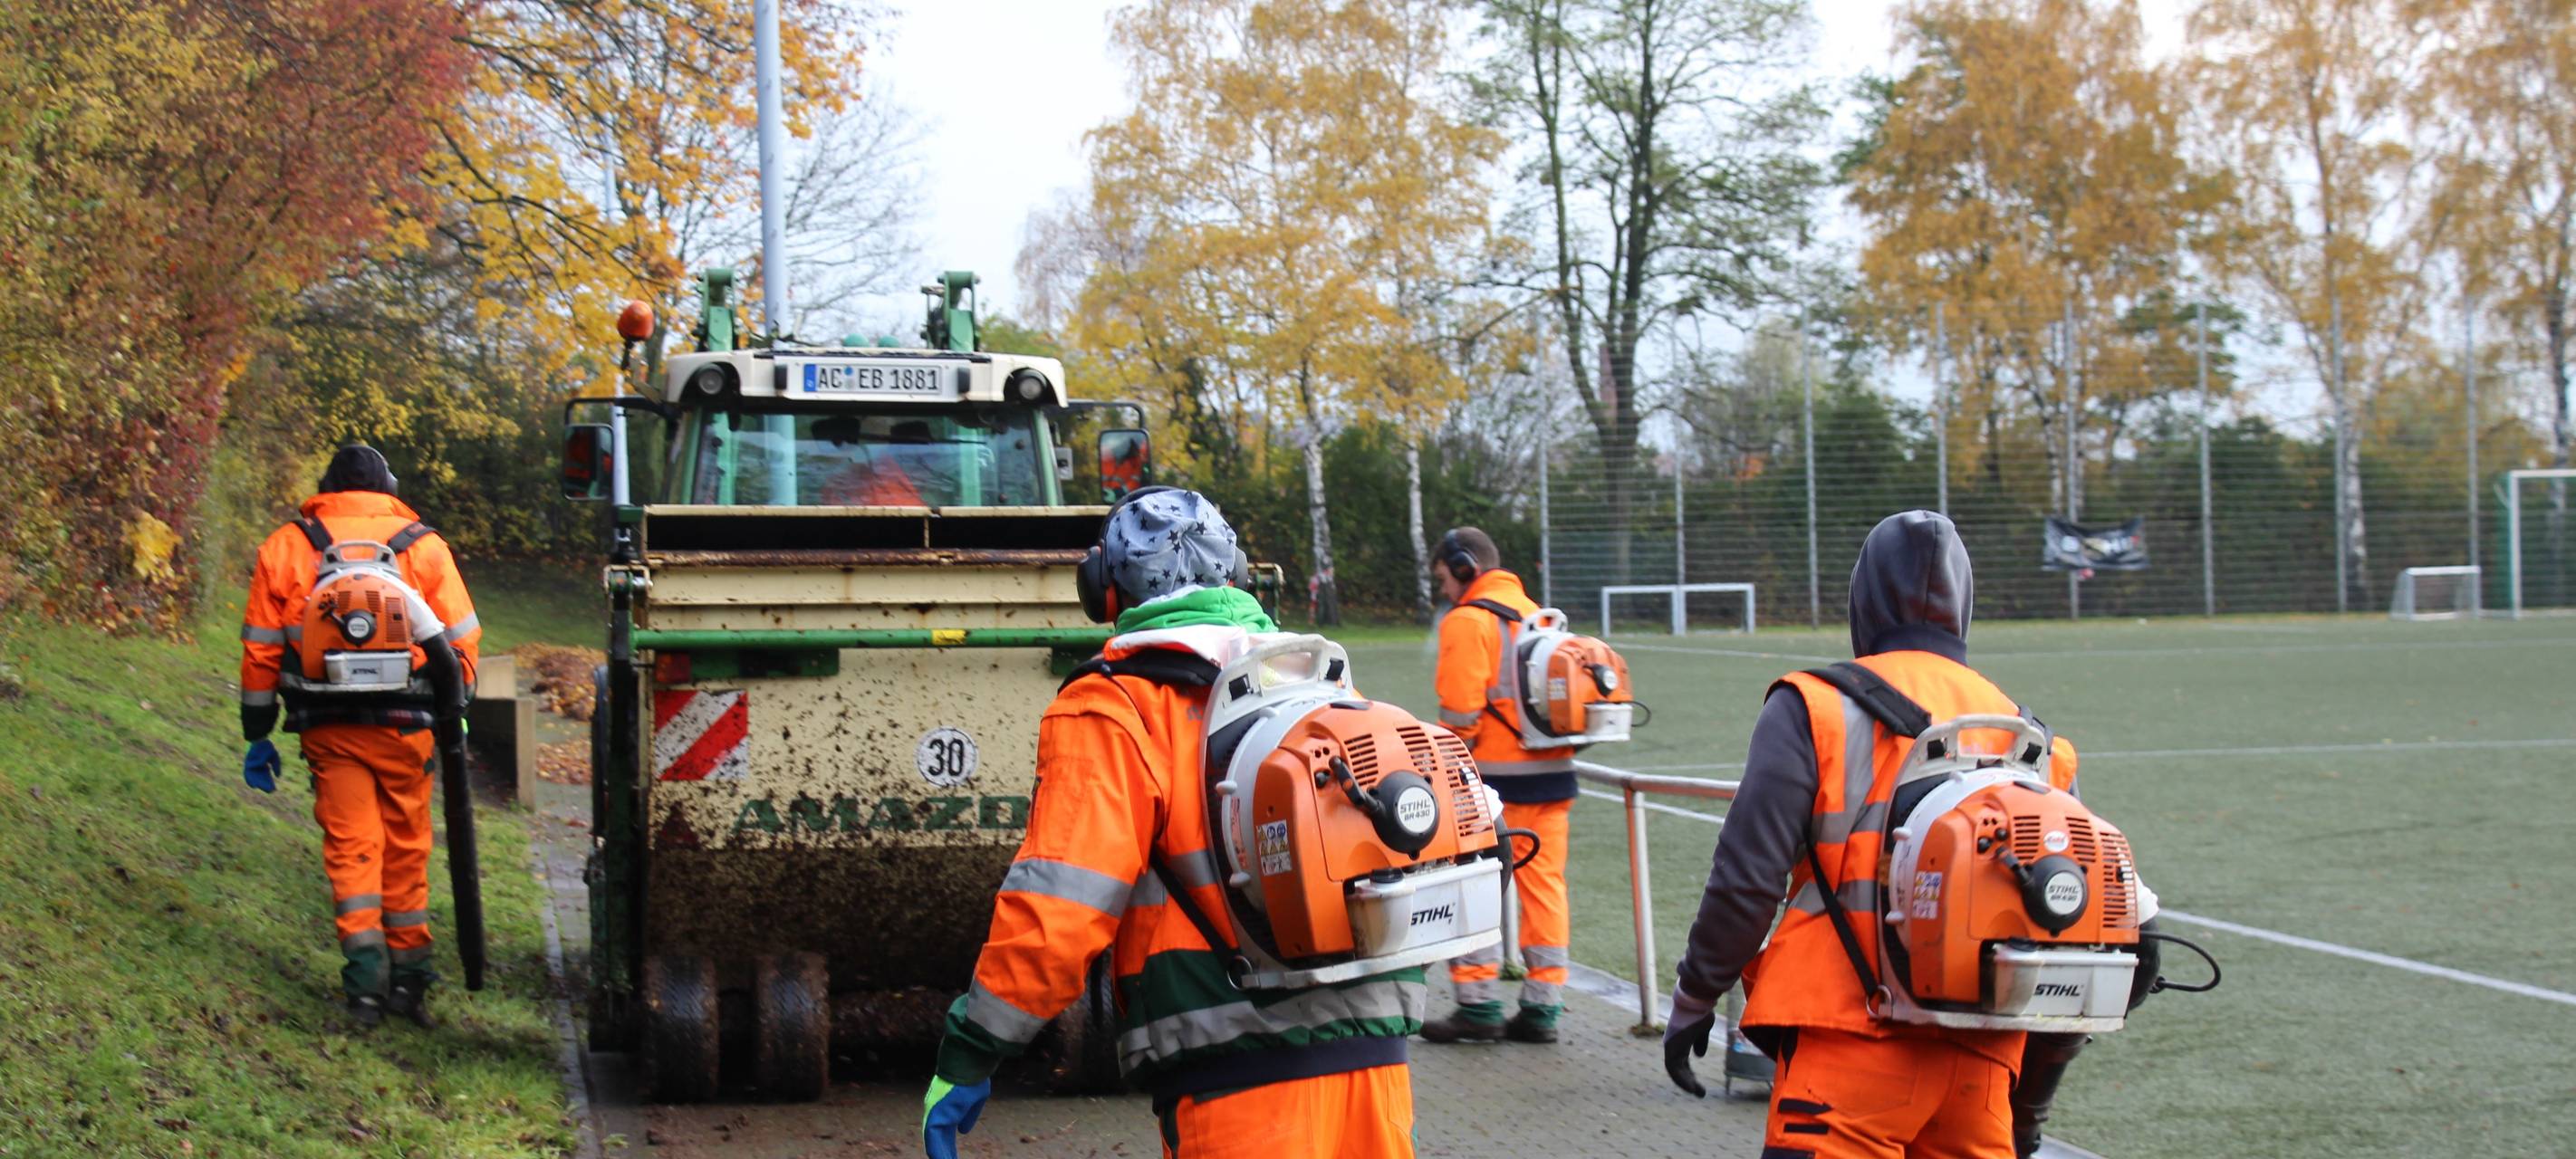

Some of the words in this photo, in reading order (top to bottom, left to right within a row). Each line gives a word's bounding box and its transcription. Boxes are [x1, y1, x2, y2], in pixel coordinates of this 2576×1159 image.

[818, 368, 842, 388] AC
[859, 369, 883, 389] EB
[889, 369, 938, 390] 1881
[928, 738, 964, 776] 30
[1400, 798, 1431, 815] STIHL
[2048, 884, 2079, 895] STIHL
[1410, 904, 1454, 926] STIHL
[2033, 982, 2081, 997] STIHL
